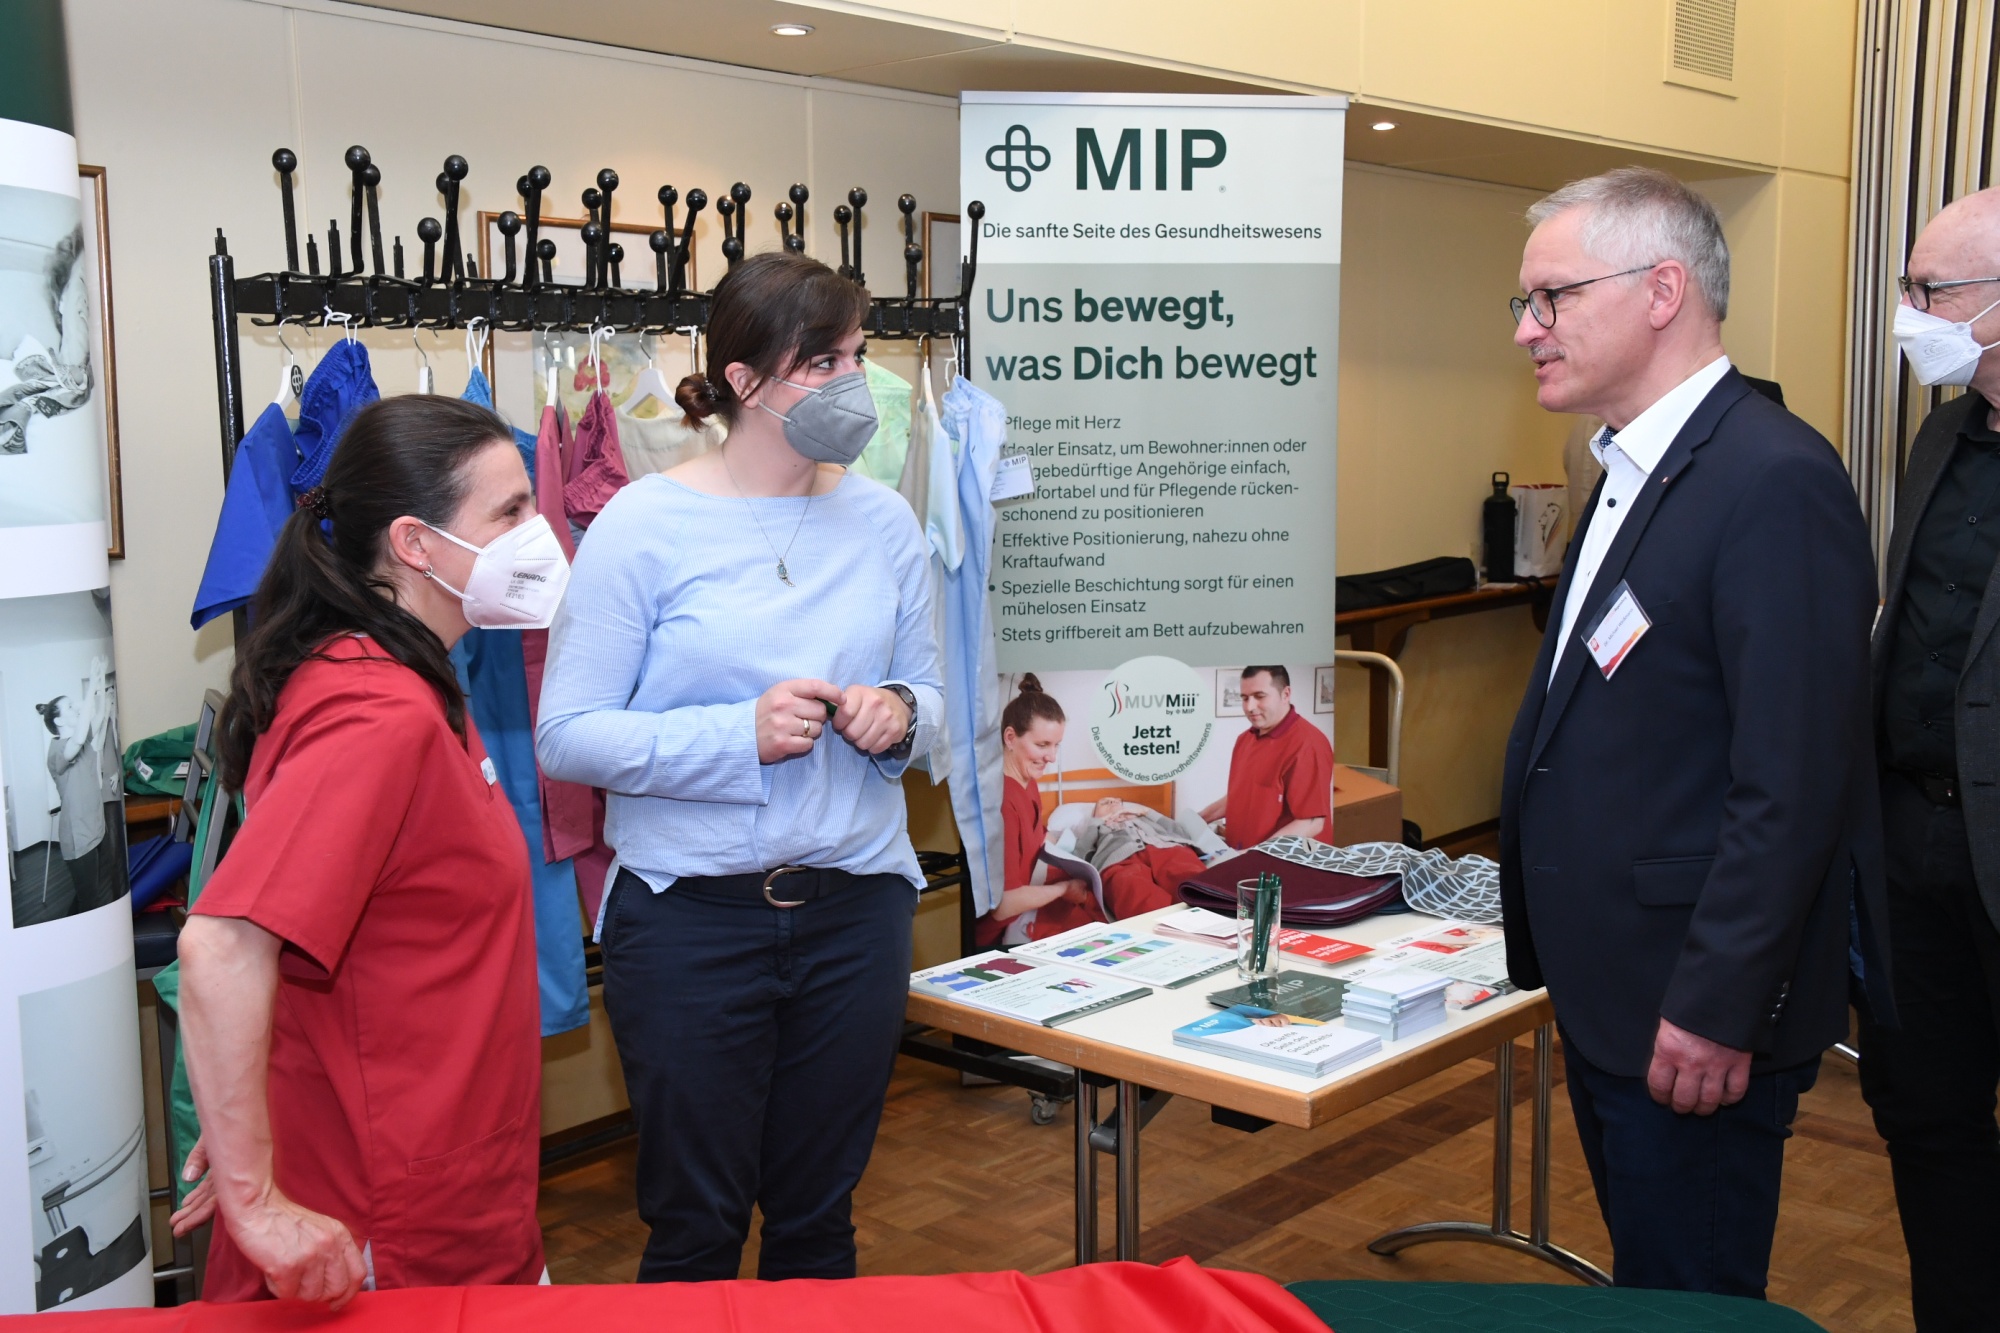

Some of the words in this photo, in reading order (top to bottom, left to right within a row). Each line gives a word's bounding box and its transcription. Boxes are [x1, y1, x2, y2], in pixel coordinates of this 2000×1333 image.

[1076, 127, 1227, 192] MIP
[984, 223, 1011, 238] Die
[1016, 223, 1068, 238] sanfte
[1073, 223, 1115, 238] Seite
[1120, 224, 1150, 238] des
[1155, 224, 1321, 238] Gesundheitswesens
[987, 289, 1062, 323] Uns
[1075, 289, 1233, 330] bewegt,
[986, 355, 1061, 381] was
[1074, 346, 1162, 380] Dich
[1176, 346, 1317, 386] bewegt
[1056, 416, 1079, 429] mit
[1085, 416, 1120, 429] Herz
[1058, 442, 1116, 457] Einsatz,
[1121, 444, 1144, 455] um
[1149, 440, 1269, 454] Bewohner:innen
[1273, 439, 1306, 452] oder
[1012, 456, 1027, 466] MIP
[1032, 463, 1132, 481] gebedürftige
[1137, 461, 1226, 478] Angehörige
[1231, 460, 1290, 475] einfach,
[1008, 484, 1096, 500] fortabel
[1101, 484, 1129, 498] und
[1134, 484, 1154, 497] für
[1160, 482, 1236, 499] Pflegende
[1242, 482, 1299, 495] rücken-
[1002, 506, 1077, 521] schonend
[1082, 509, 1099, 519] zu
[1105, 505, 1203, 522] positionieren
[1003, 533, 1068, 547] Effektive
[1074, 531, 1188, 546] Positionierung,
[1193, 529, 1247, 543] nahezu
[1252, 528, 1289, 542] ohne
[1002, 553, 1104, 568] Kraftaufwand
[512, 571, 547, 583] LEIKANG
[1002, 580, 1070, 597] Spezielle
[1075, 578, 1179, 593] Beschichtung
[1184, 577, 1223, 592] sorgt
[1228, 575, 1248, 588] für
[1253, 575, 1293, 588] einen
[1003, 601, 1086, 615] mühelosen
[1091, 600, 1146, 613] Einsatz
[1002, 628, 1041, 641] Stets
[1045, 626, 1121, 643] griffbereit
[1126, 627, 1148, 638] am
[1154, 624, 1184, 637] Bett
[1189, 621, 1303, 636] aufzubewahren
[1132, 725, 1172, 739] Jetzt
[1091, 726, 1101, 742] Die
[1096, 741, 1116, 766] sanfte
[1113, 762, 1134, 778] Seite
[1134, 772, 1151, 782] des
[1151, 722, 1212, 782] Gesundheitswesens
[1123, 740, 1180, 756] testen!
[915, 970, 935, 980] MIP
[1271, 979, 1305, 995] MIP
